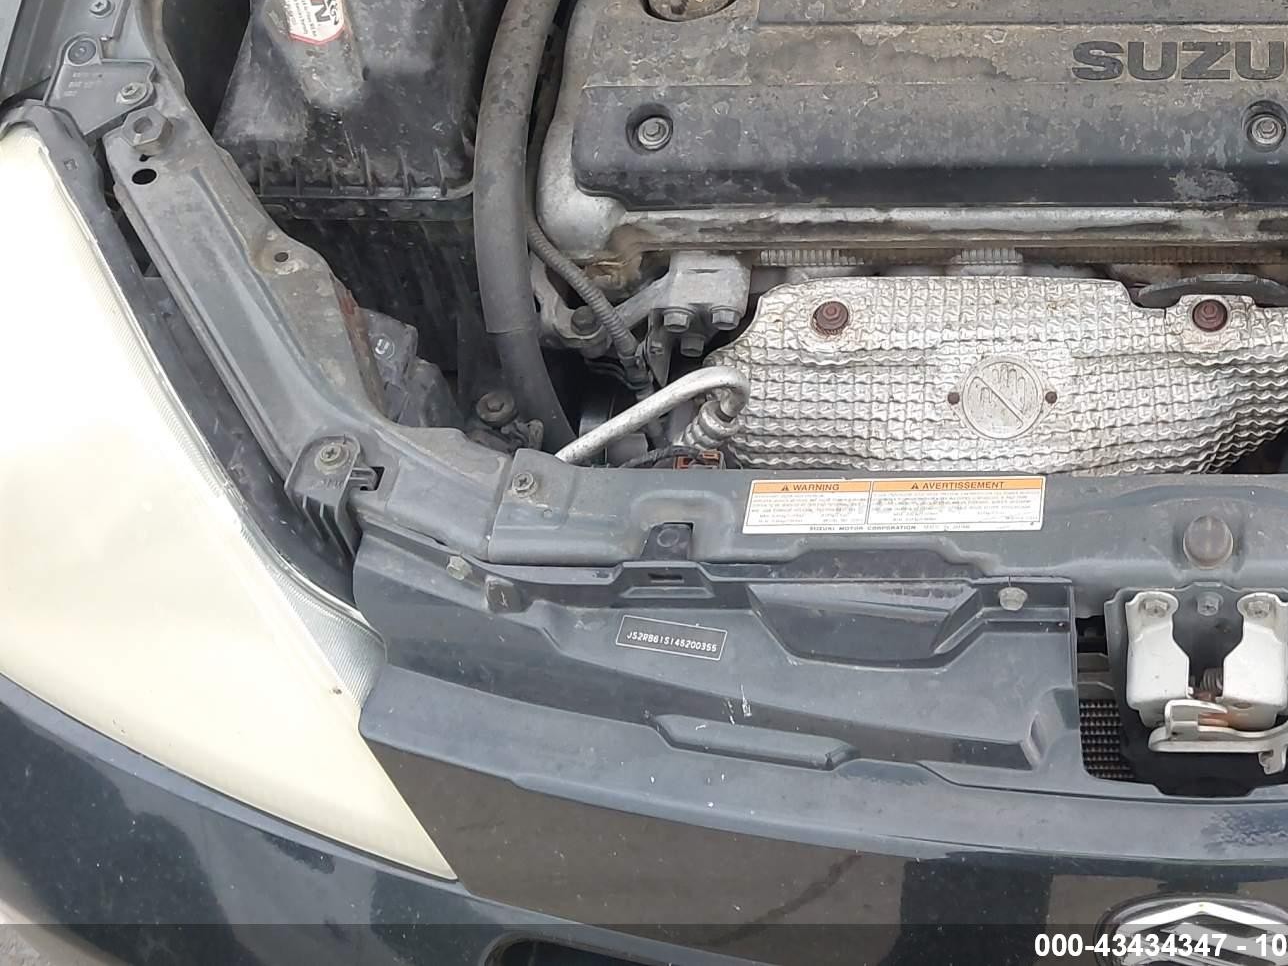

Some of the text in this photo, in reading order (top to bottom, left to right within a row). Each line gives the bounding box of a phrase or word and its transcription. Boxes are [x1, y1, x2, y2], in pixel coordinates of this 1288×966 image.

[793, 483, 840, 491] WARNING
[922, 481, 1006, 490] AVERTISSEMENT
[626, 631, 718, 652] JS2RB61S145200355
